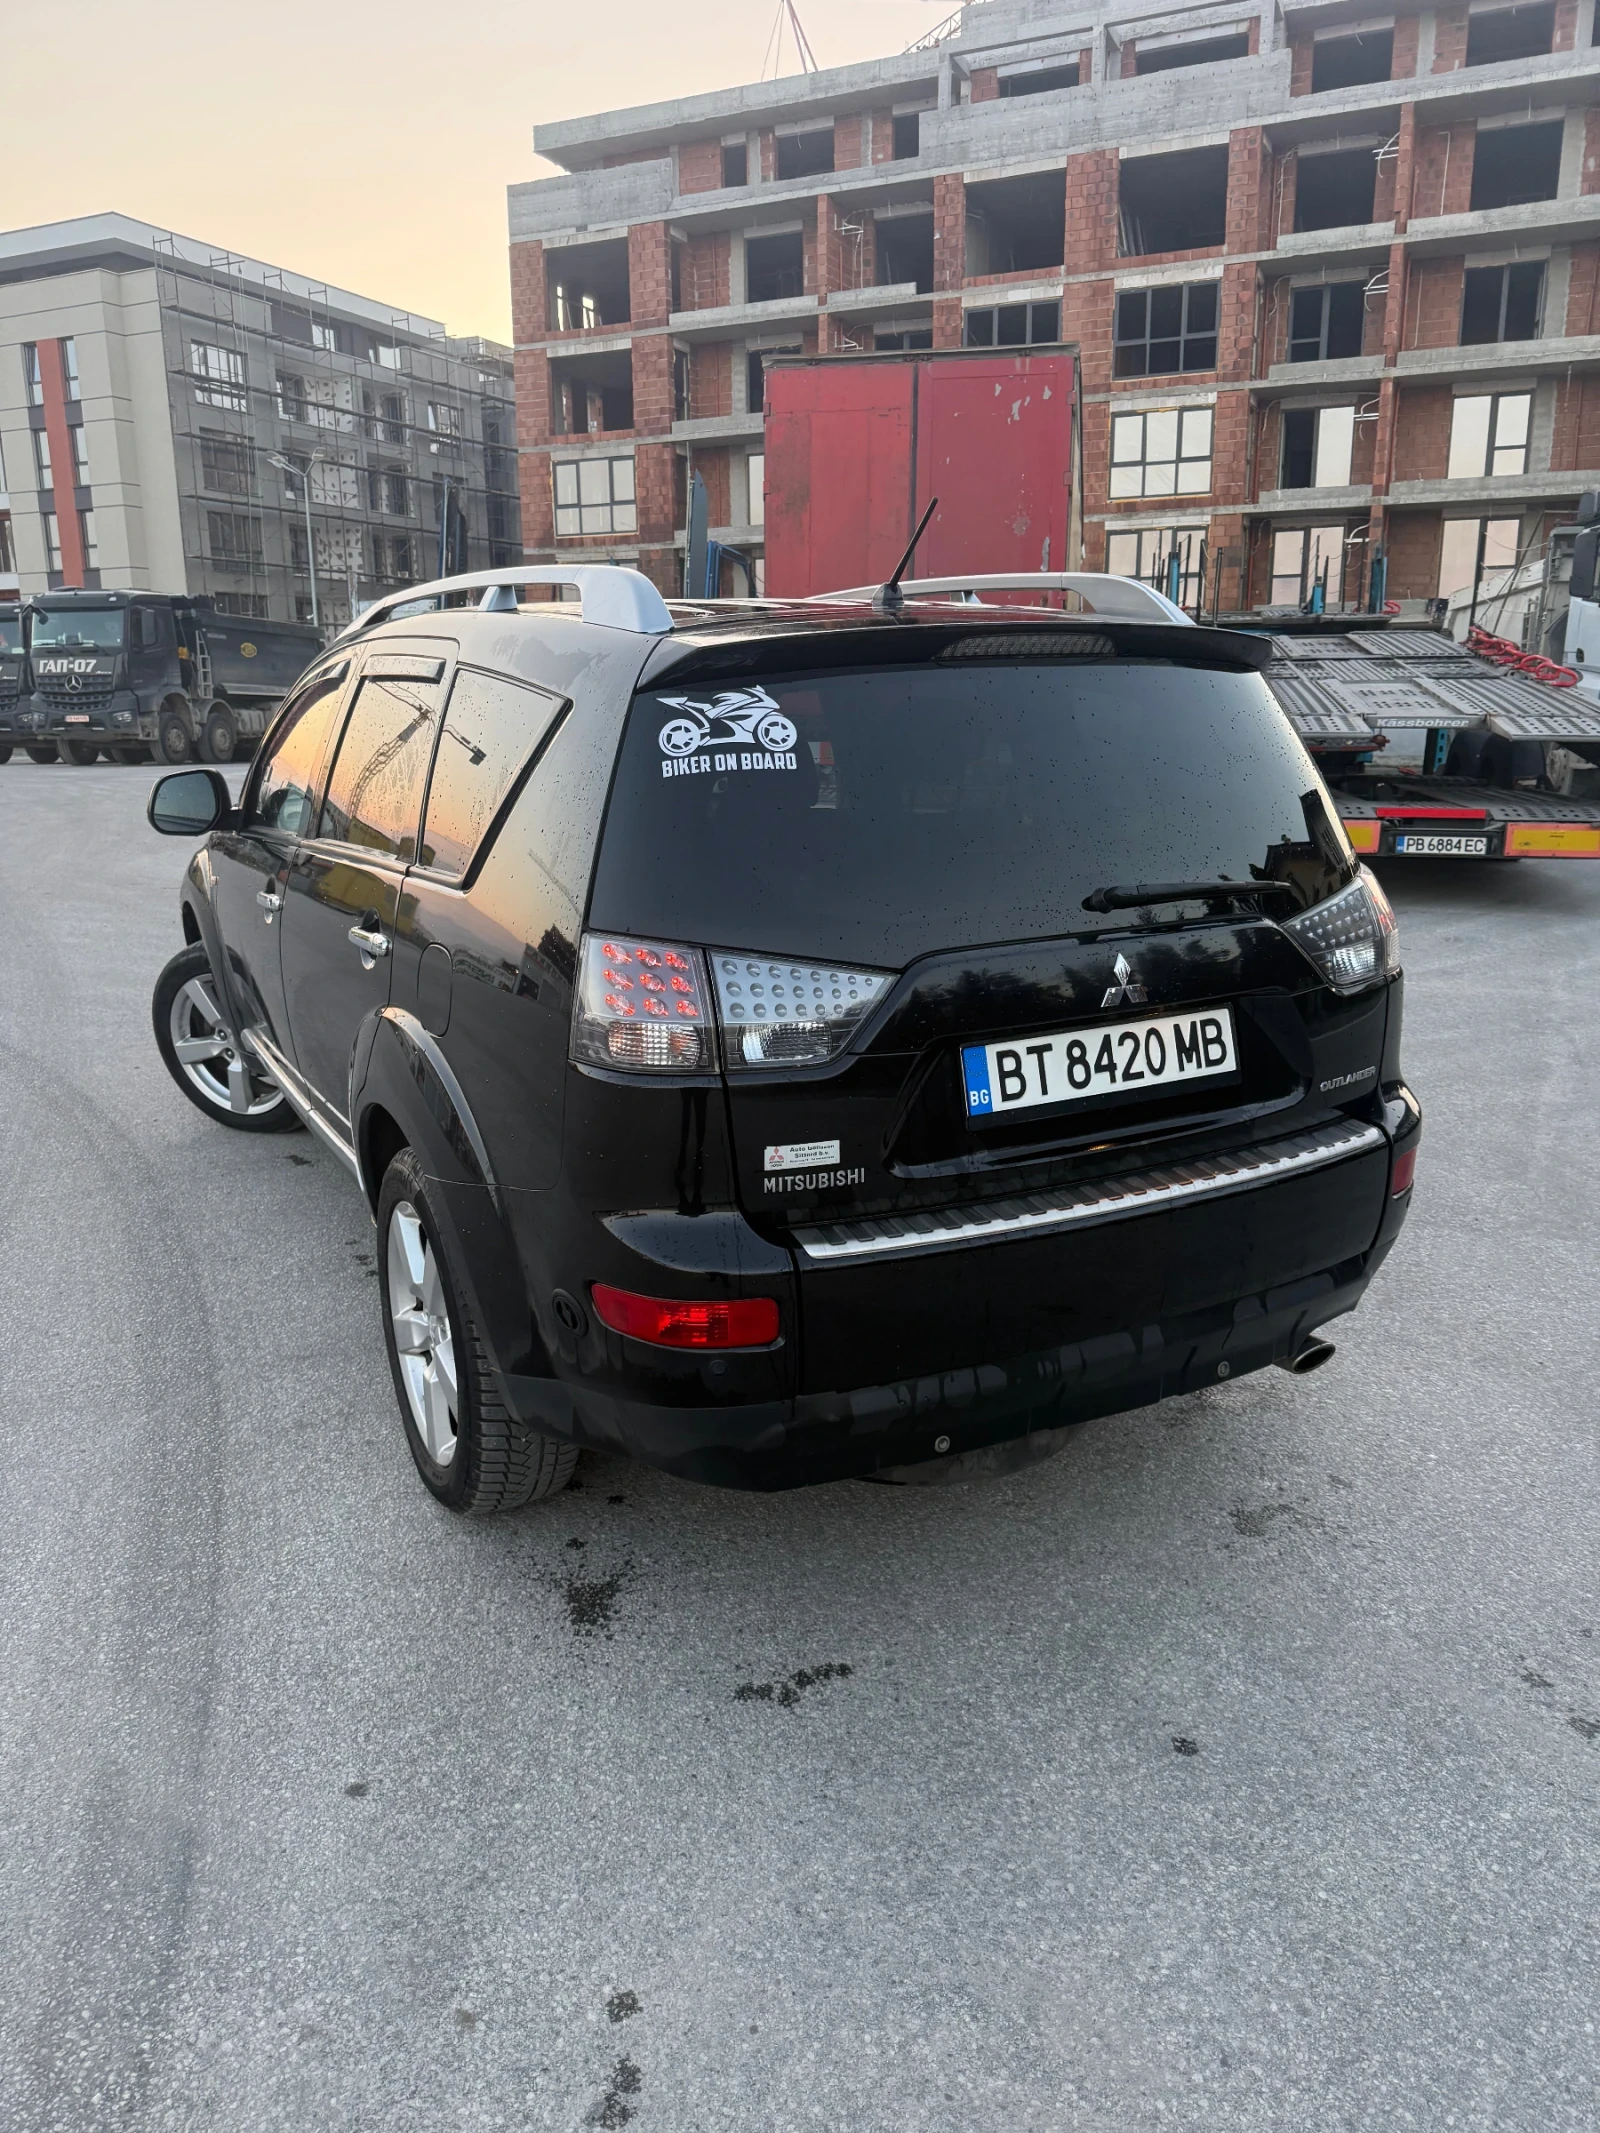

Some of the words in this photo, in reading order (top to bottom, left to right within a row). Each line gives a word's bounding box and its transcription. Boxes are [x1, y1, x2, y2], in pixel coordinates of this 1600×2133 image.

[1376, 718, 1469, 727] Kässbohrer
[662, 755, 711, 778] BIKER
[715, 753, 737, 771] ON
[741, 752, 797, 770] BOARD
[1406, 838, 1425, 851] PB
[1428, 838, 1462, 852] 6884
[1464, 839, 1484, 852] EC
[996, 1043, 1053, 1103] BT
[1066, 1027, 1166, 1090] 8420
[1173, 1017, 1228, 1072] MB
[1320, 1065, 1376, 1092] OUTLANDER
[970, 1089, 989, 1107] BG
[764, 1167, 865, 1193] MITSUBISHI
